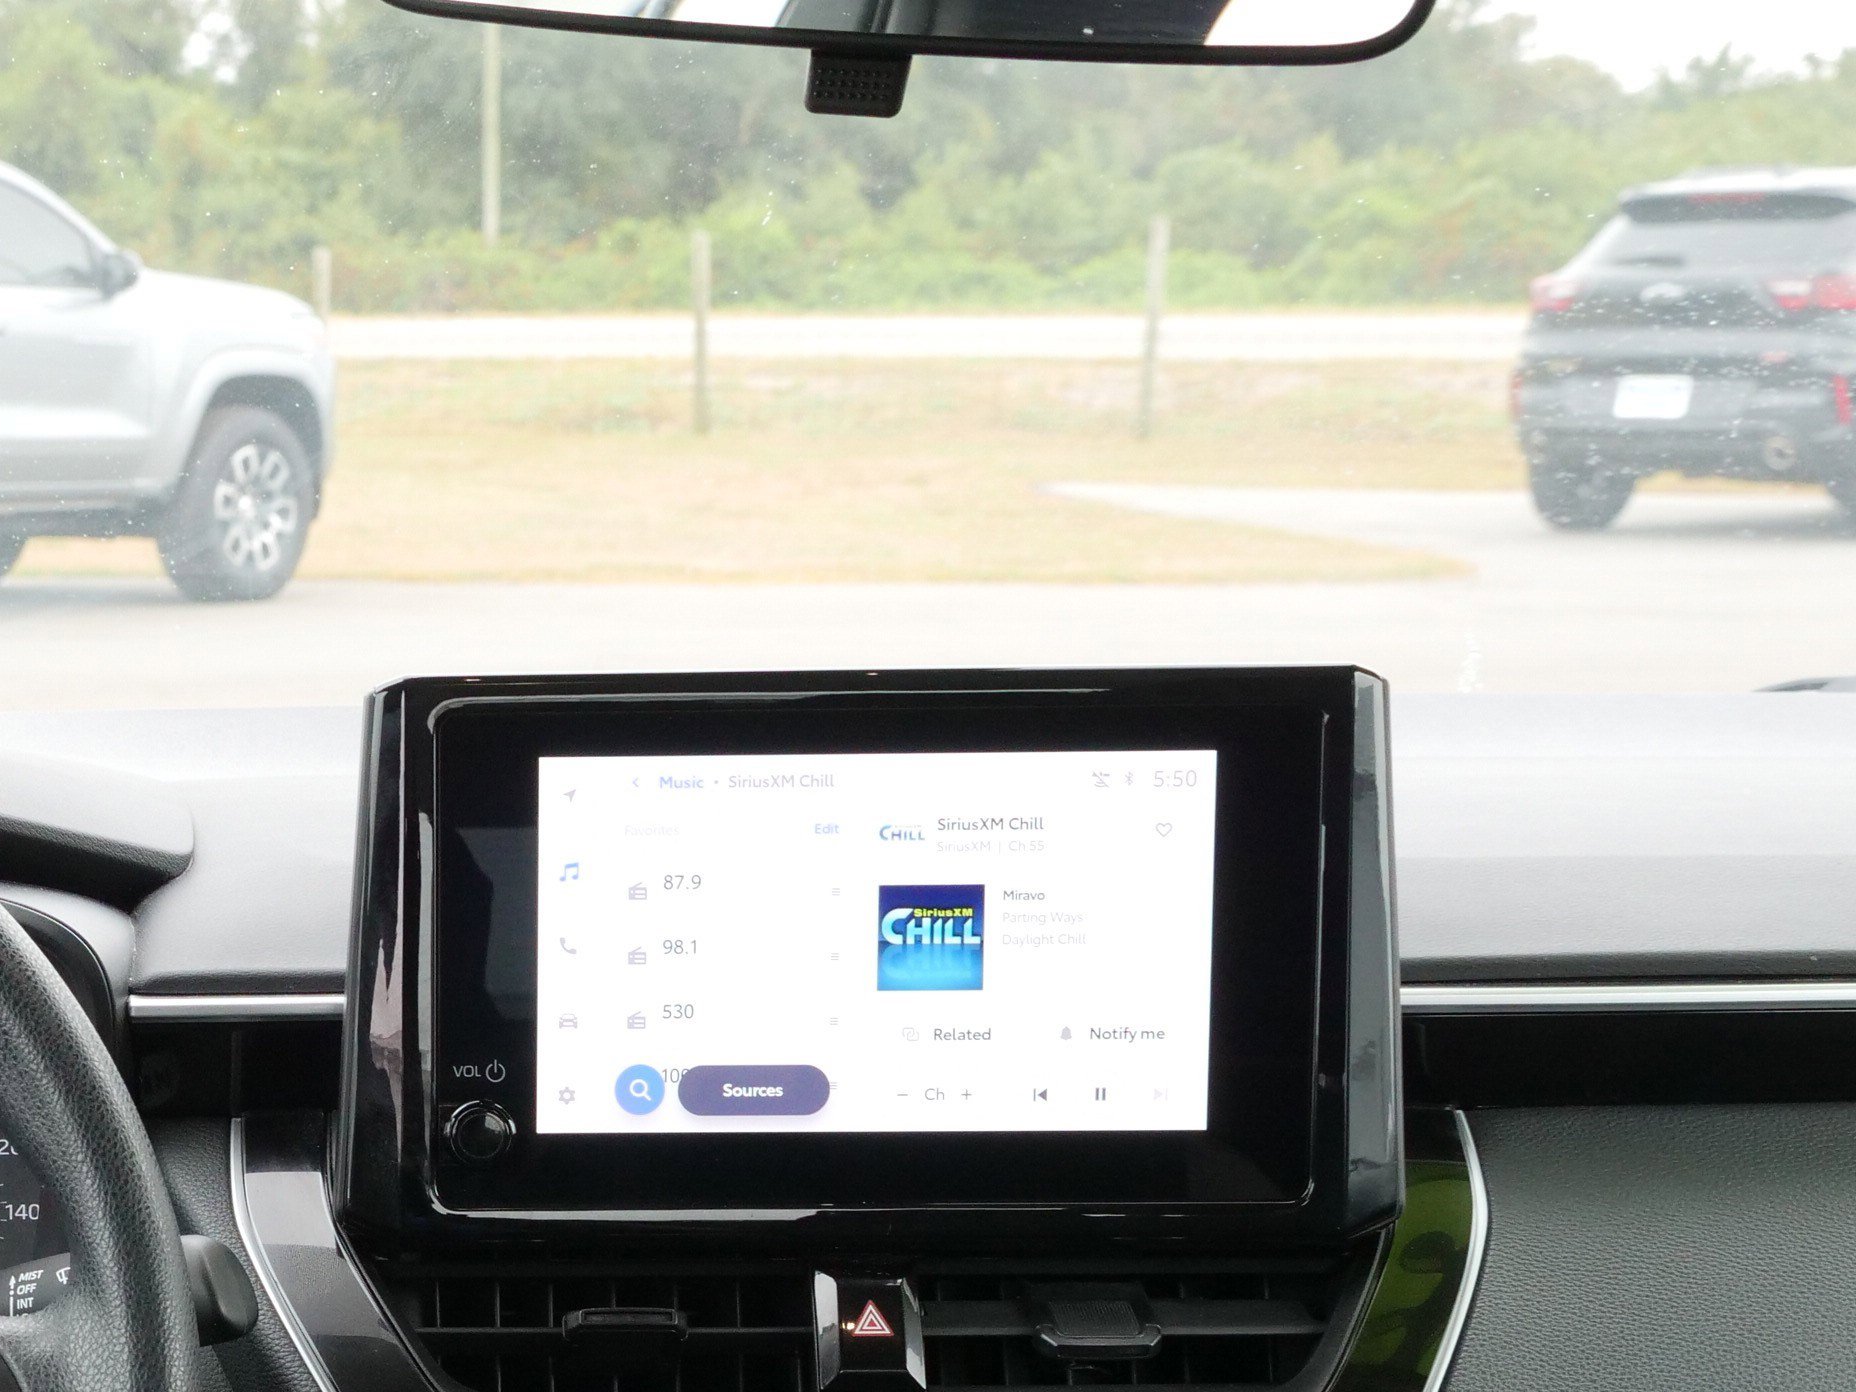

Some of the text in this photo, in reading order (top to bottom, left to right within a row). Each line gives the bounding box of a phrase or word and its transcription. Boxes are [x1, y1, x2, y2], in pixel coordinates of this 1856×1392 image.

[659, 774, 835, 789] Music SiriusXM Chill
[1153, 769, 1198, 788] 5:50
[814, 823, 840, 835] Edit
[937, 817, 1045, 831] SiriusXM Chill
[879, 824, 926, 841] CHILL
[937, 840, 1045, 852] SiriusXM Ch 55
[663, 874, 702, 890] 87.9
[1002, 889, 1046, 901] Miravo
[913, 907, 974, 918] SiriusXM
[1002, 911, 1085, 926] Parting Ways
[881, 907, 982, 945] CHILL
[662, 939, 697, 955] 98.1
[1002, 933, 1088, 948] Daylight Chill
[662, 1004, 694, 1019] 530
[933, 1027, 992, 1041] Related
[1089, 1026, 1166, 1043] Notify me
[452, 1065, 482, 1078] VOL
[722, 1083, 784, 1098] Sources
[924, 1087, 945, 1101] Ch
[5, 1203, 40, 1221] 140
[18, 1269, 44, 1283] MIST
[16, 1282, 37, 1295] OFF
[16, 1297, 34, 1310] INT
